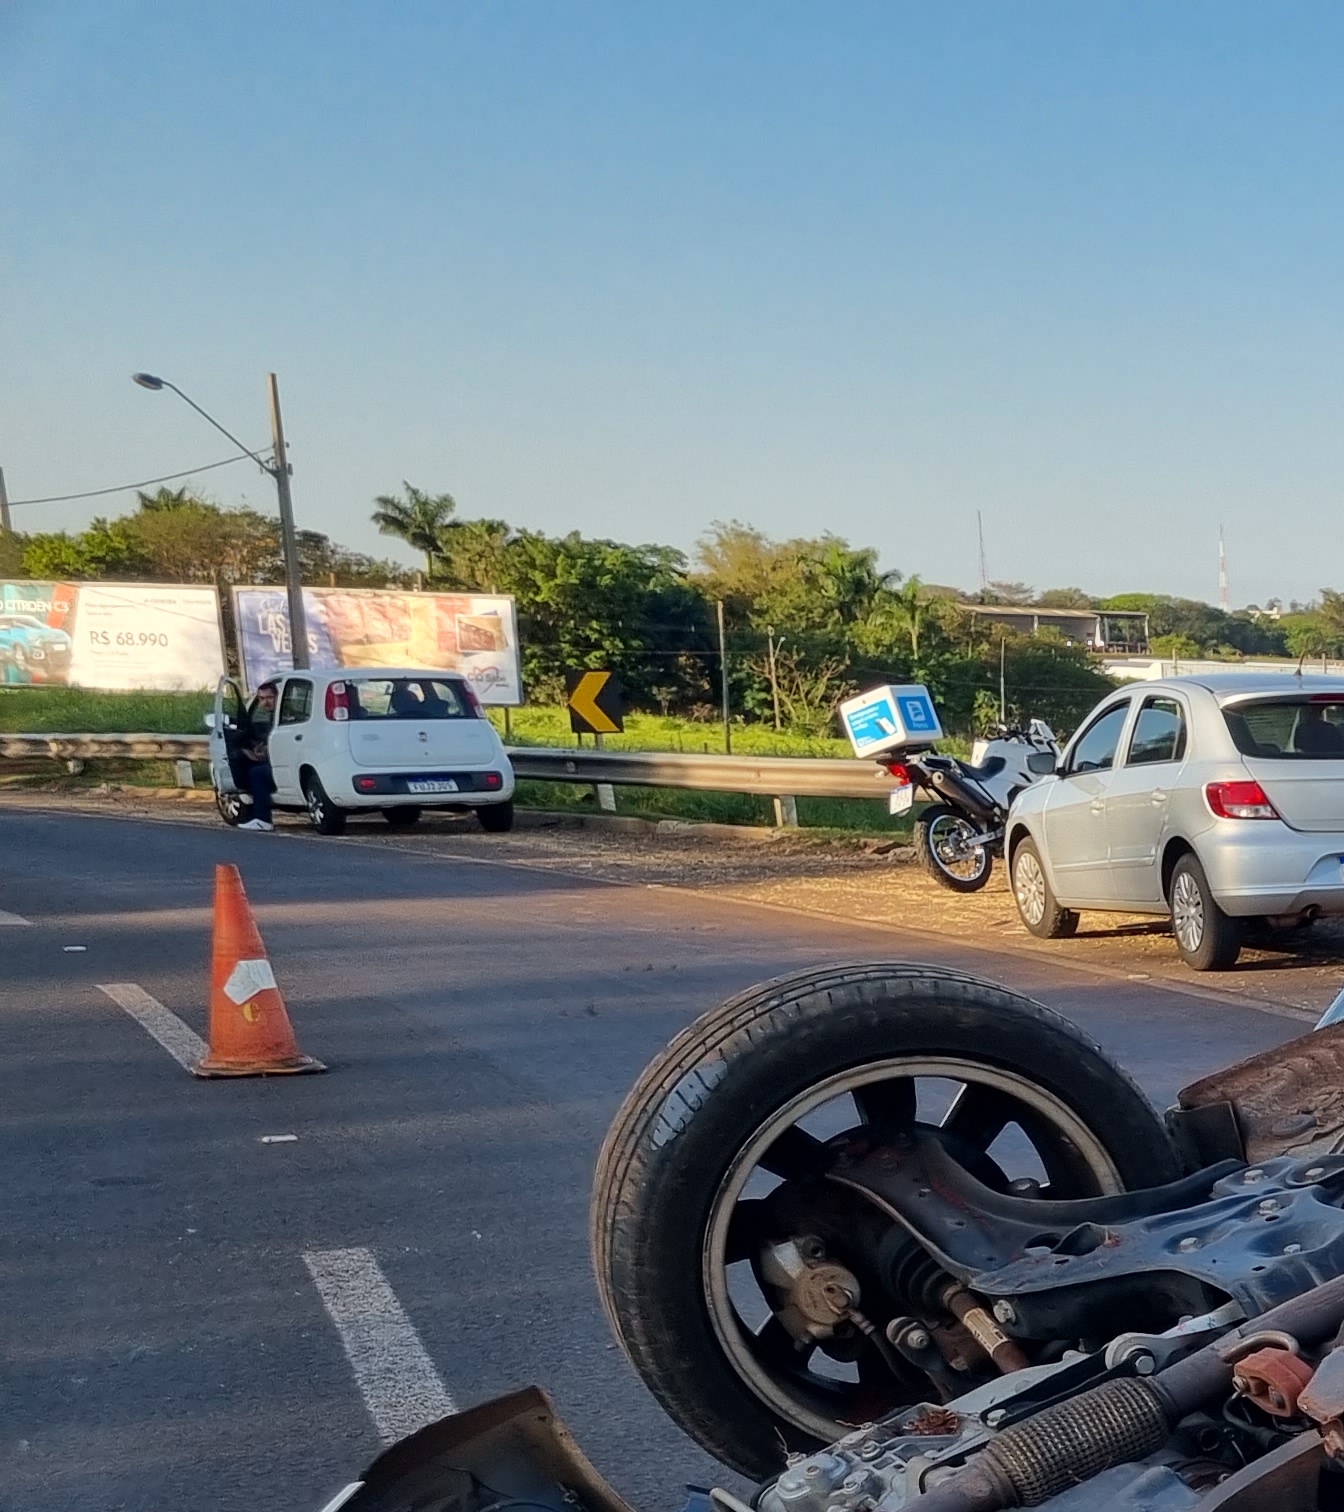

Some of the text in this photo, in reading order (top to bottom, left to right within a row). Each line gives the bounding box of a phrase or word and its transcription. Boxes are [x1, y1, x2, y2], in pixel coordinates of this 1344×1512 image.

[53, 601, 69, 613] C3
[256, 613, 286, 635] LAS
[116, 631, 169, 647] 68.990
[271, 631, 319, 655] VES
